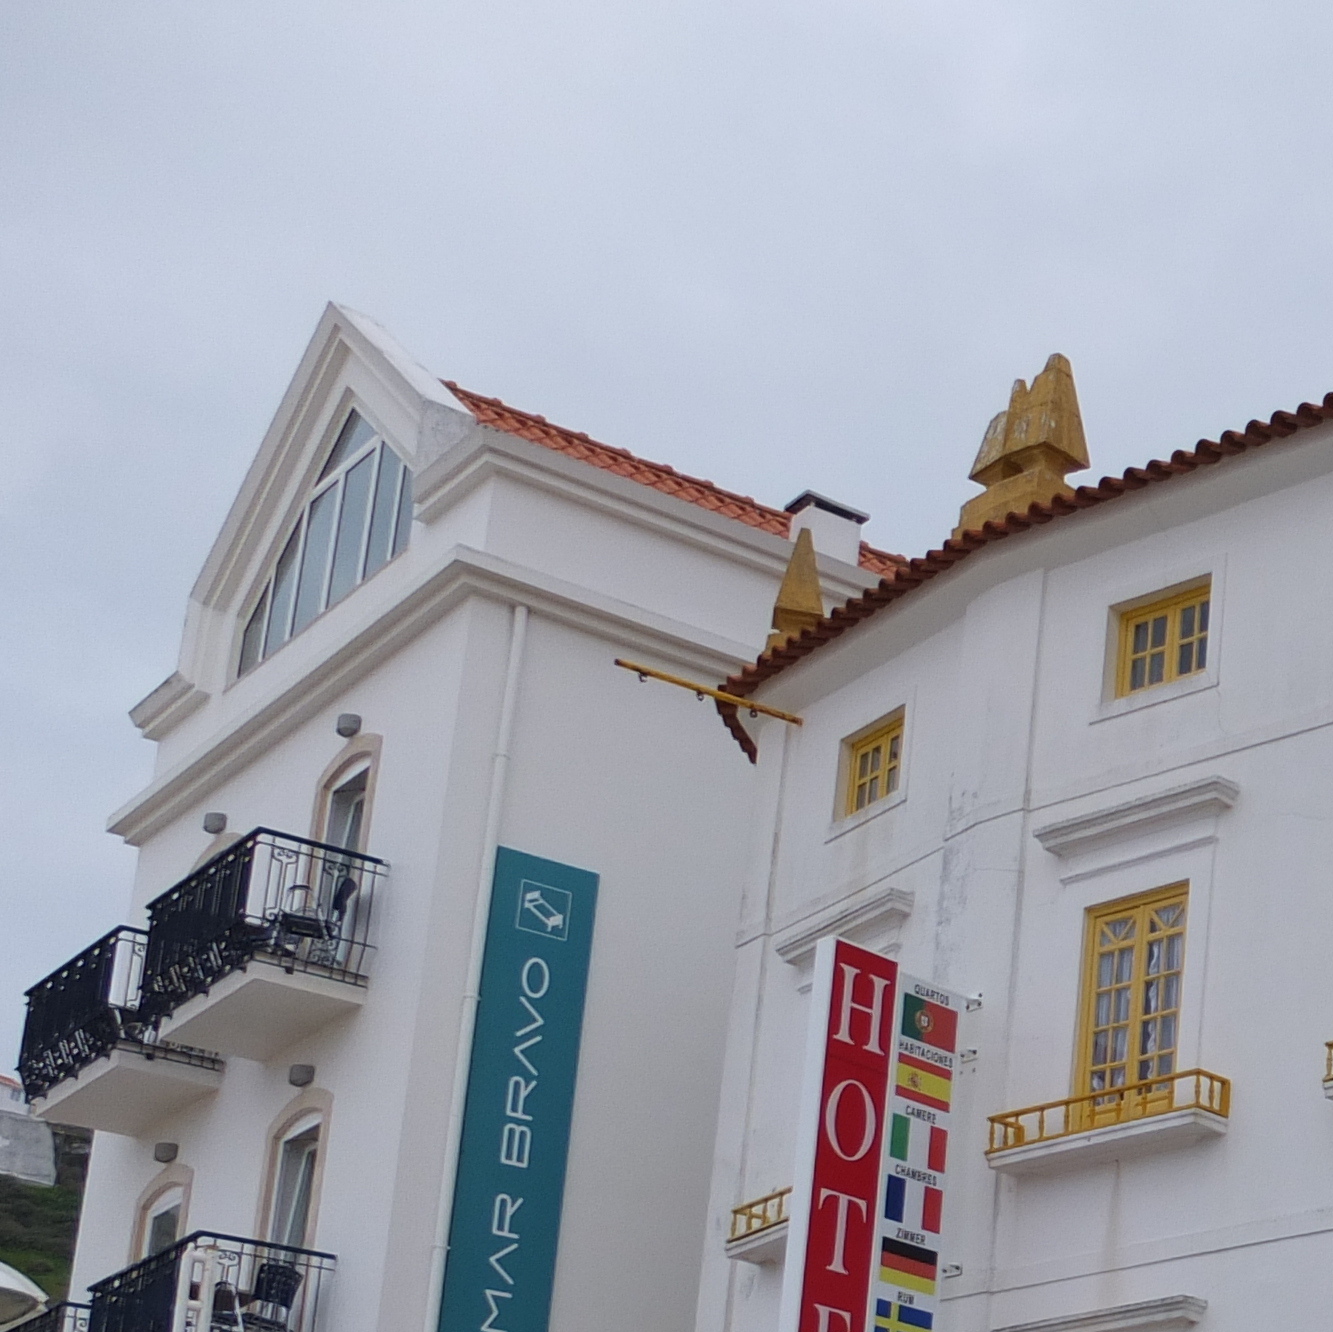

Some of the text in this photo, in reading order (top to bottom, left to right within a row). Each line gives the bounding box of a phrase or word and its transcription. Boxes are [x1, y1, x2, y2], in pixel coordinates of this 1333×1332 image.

[913, 983, 950, 1006] QUARTOS
[500, 957, 551, 1170] BRAVO
[898, 1041, 954, 1069] HABITACIONES
[905, 1104, 937, 1125] CAMERE
[894, 1163, 938, 1187] CHAMBRES
[895, 1227, 926, 1246] ZIMMER
